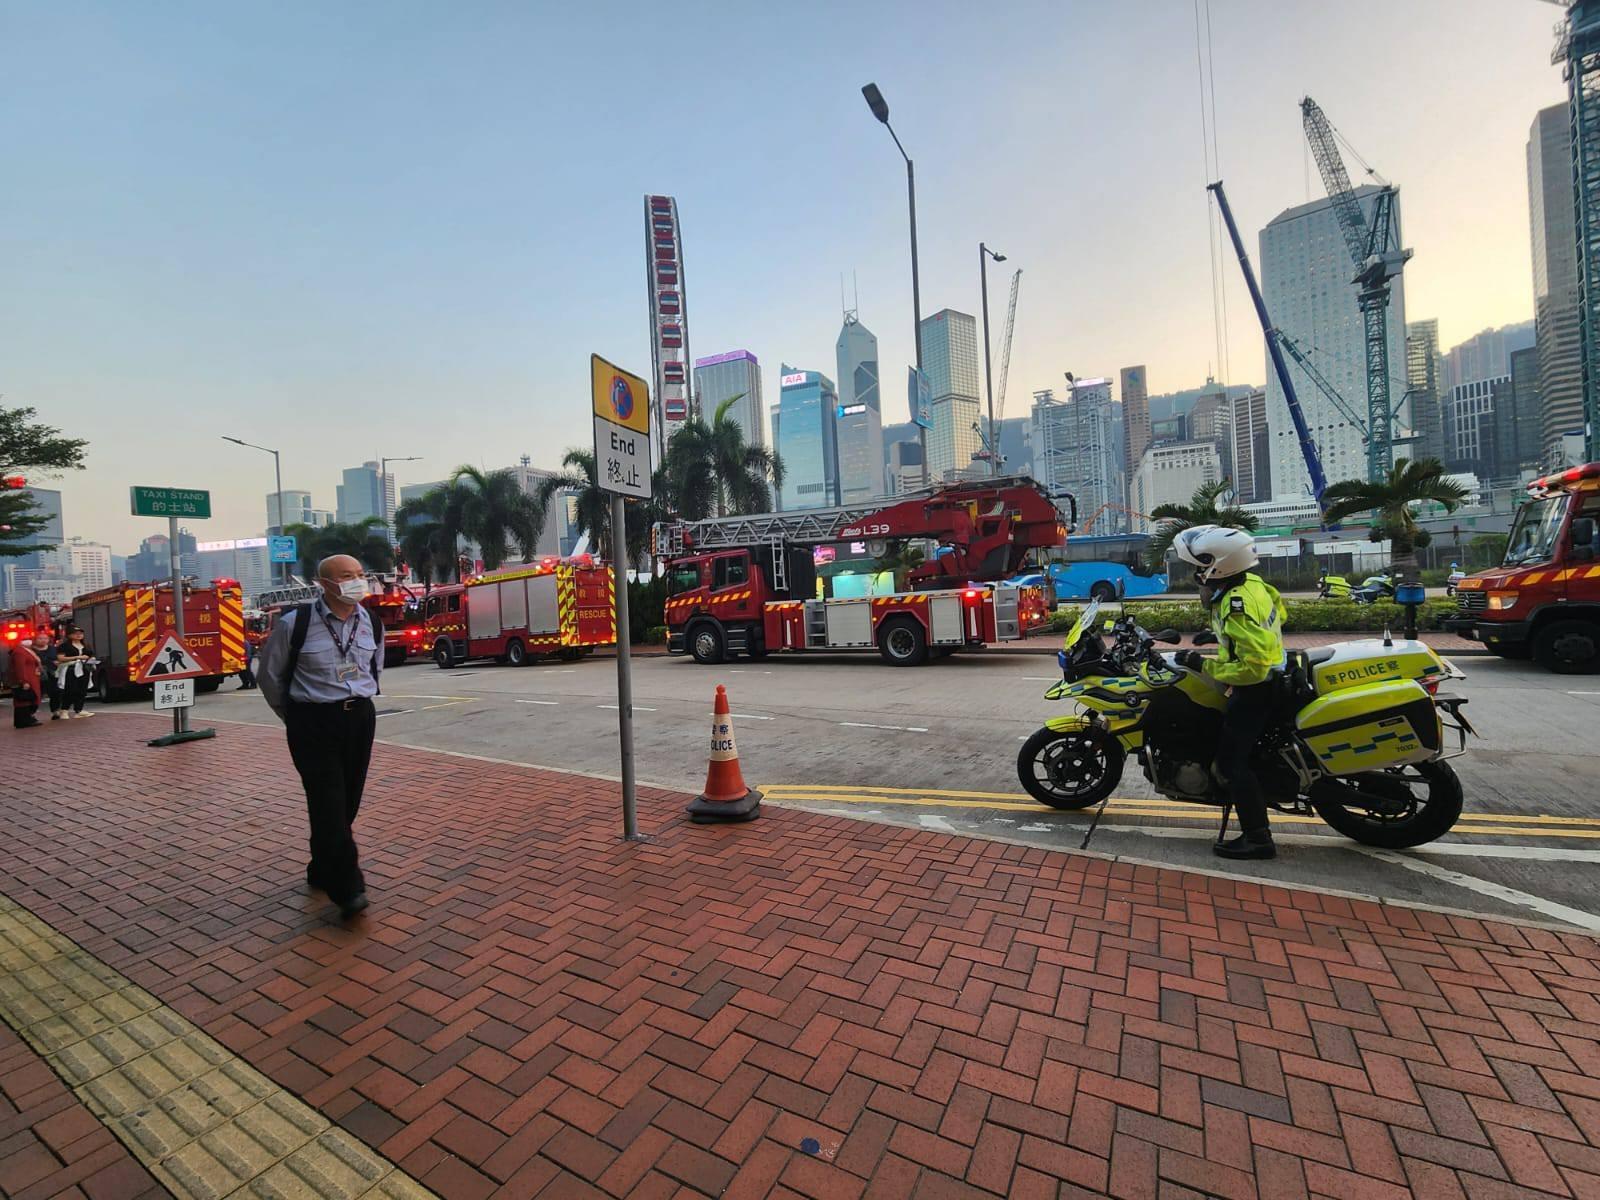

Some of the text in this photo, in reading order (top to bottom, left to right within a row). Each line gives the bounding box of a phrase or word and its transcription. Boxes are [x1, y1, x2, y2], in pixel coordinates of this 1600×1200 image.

[784, 375, 802, 384] AIA
[611, 431, 635, 456] End
[607, 457, 641, 488] 終止
[142, 490, 205, 501] TAXI STAND
[151, 501, 196, 512] 的士站
[863, 524, 890, 535] L39
[579, 609, 607, 619] RESCUE
[1338, 663, 1386, 683] POLICE
[164, 682, 185, 691] End
